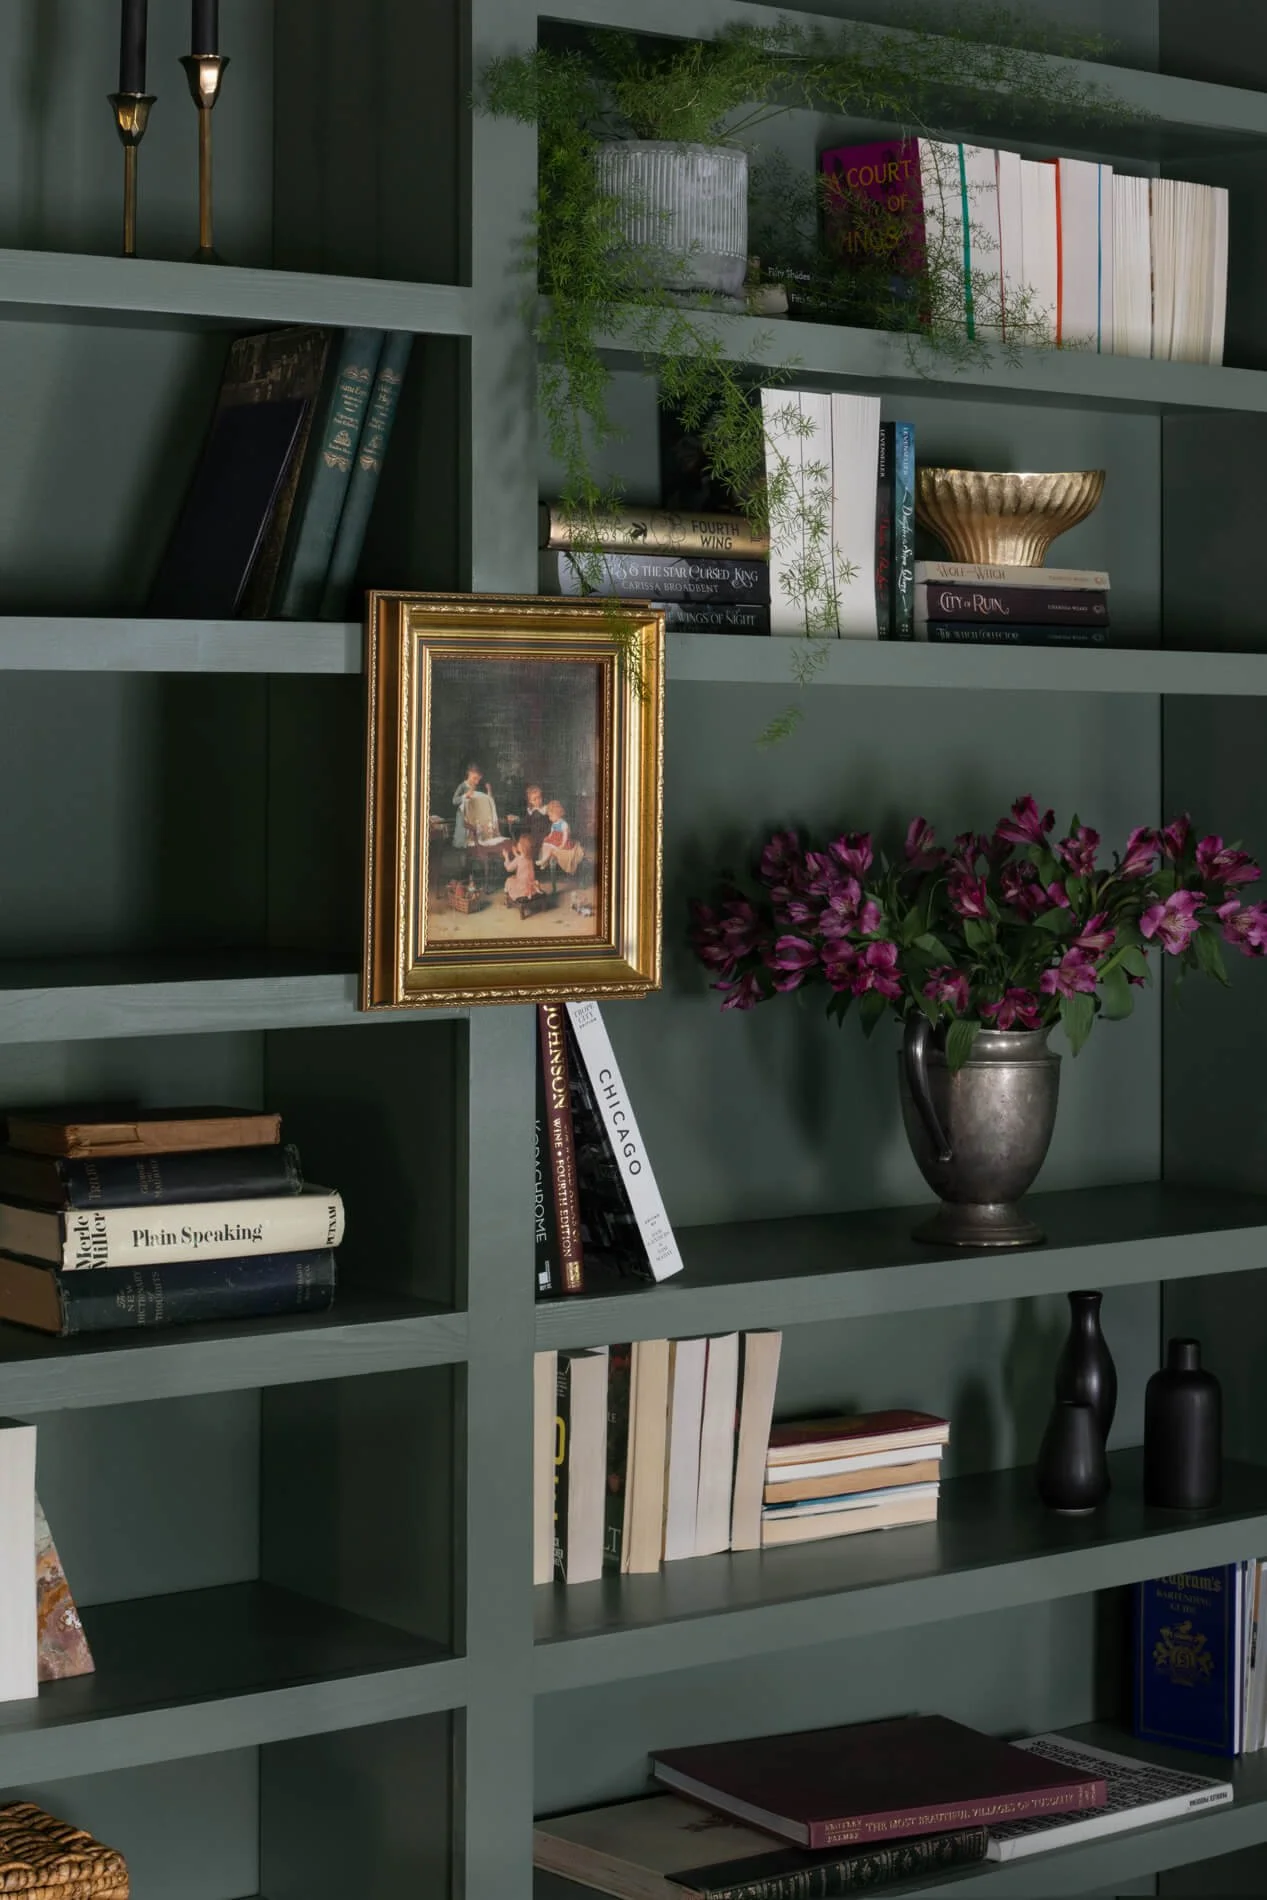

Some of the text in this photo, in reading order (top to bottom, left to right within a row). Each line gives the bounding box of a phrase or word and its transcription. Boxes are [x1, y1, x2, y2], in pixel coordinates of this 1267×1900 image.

[847, 160, 912, 188] COURT
[887, 193, 909, 212] OF
[692, 520, 740, 537] FOURTH
[701, 535, 732, 550] WING
[622, 581, 720, 593] CARISSA BROADBENT
[641, 565, 661, 577] THE
[663, 566, 687, 579] STAR
[688, 564, 730, 582] CURSED
[732, 567, 759, 589] KING
[940, 592, 962, 613] CITY
[973, 594, 1009, 615] RUIN
[677, 611, 708, 625] WINGS
[710, 612, 723, 625] OF
[545, 1004, 568, 1109] JOHNSON
[599, 1069, 642, 1176] CHICAGO
[554, 1117, 572, 1257] WINE FOURTH EDITION
[132, 1223, 263, 1249] Plain Speaking
[326, 1205, 337, 1246] PUTNAM
[74, 1215, 91, 1269] Merle
[91, 1212, 108, 1269] Miller
[126, 1285, 135, 1312] NEW
[133, 1271, 145, 1326] DICTIONARY
[865, 1821, 888, 1833] THE
[888, 1818, 917, 1831] MOST
[918, 1811, 970, 1826] BEAUTIFUL
[971, 1804, 1015, 1819] VILLAGES
[1030, 1793, 1074, 1810] TUSCANY
